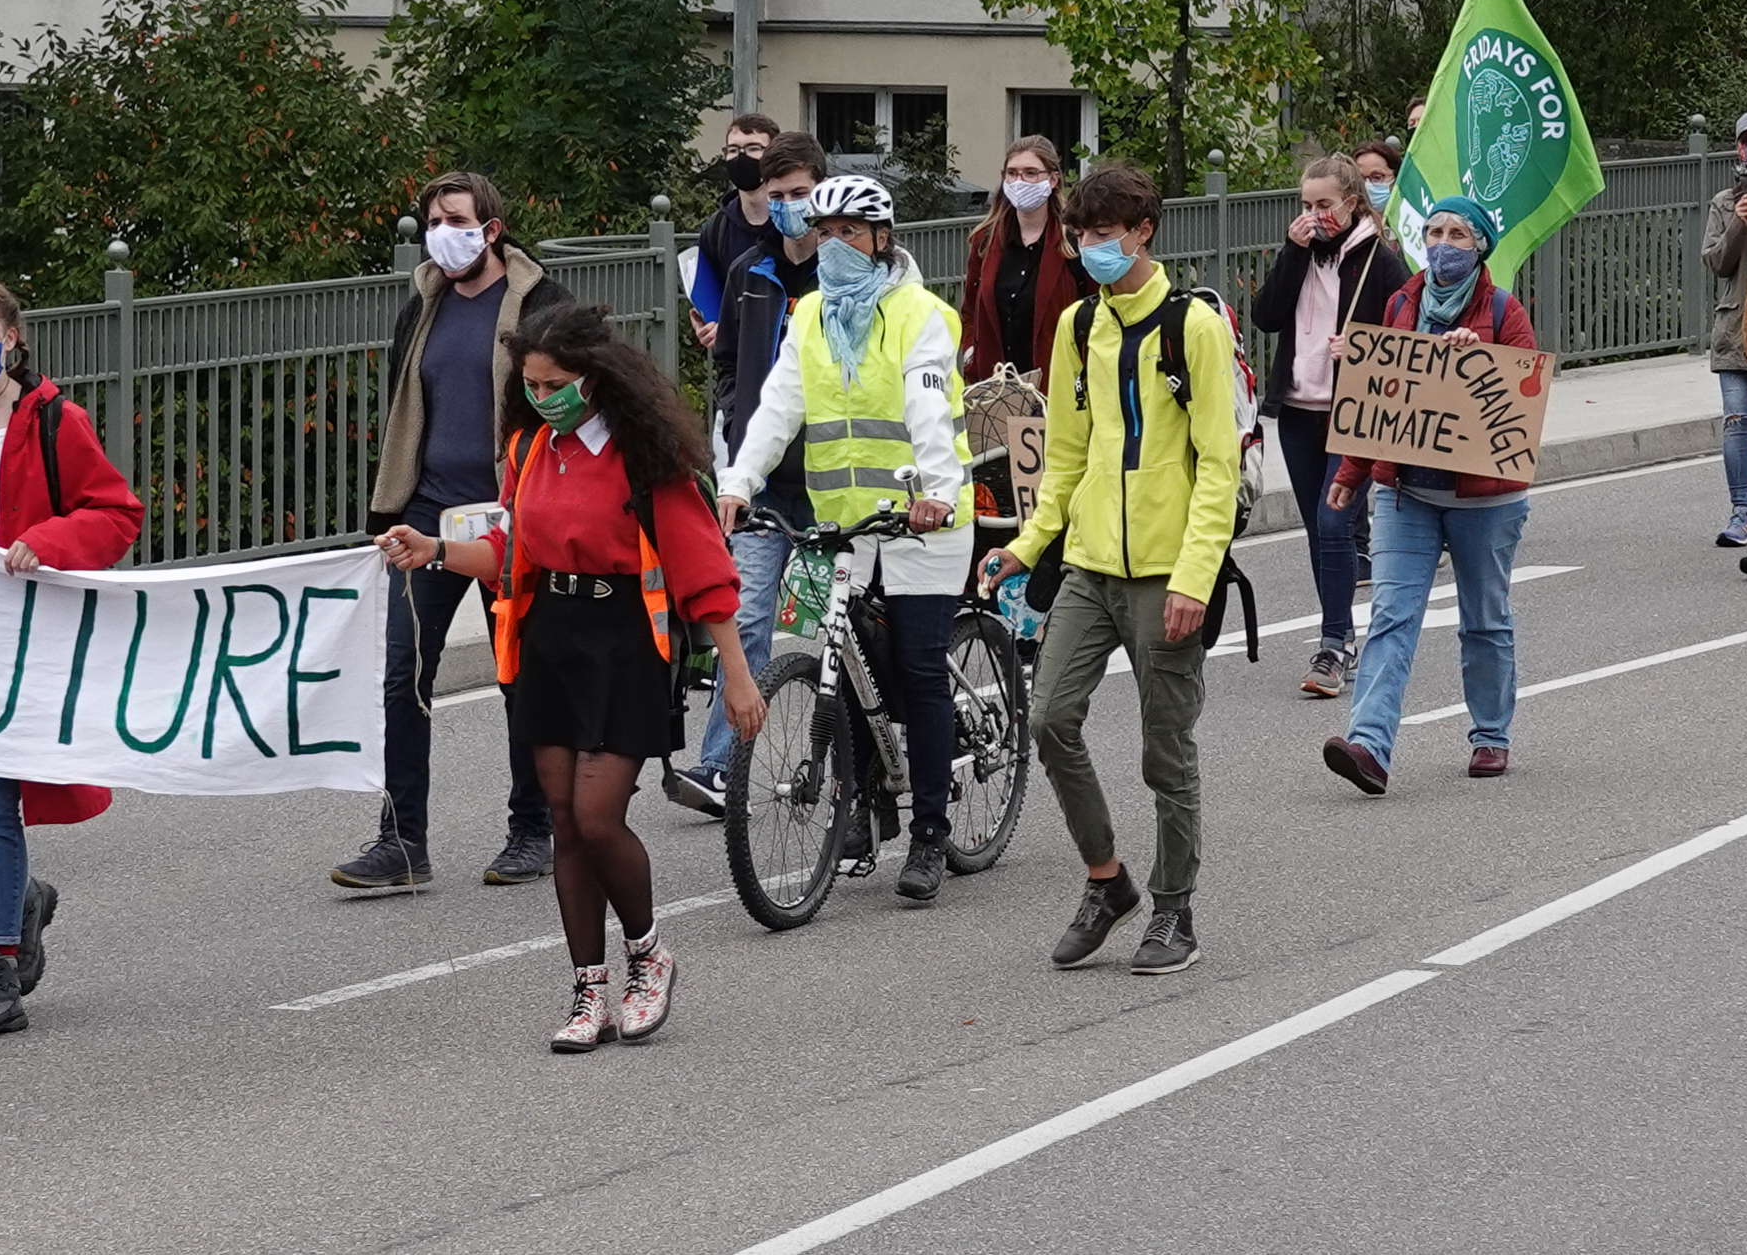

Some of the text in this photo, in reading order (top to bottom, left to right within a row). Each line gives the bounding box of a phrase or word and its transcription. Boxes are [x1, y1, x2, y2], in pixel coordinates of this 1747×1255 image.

[1463, 35, 1566, 140] FRIDAYS FOR
[1367, 375, 1421, 405] NOT
